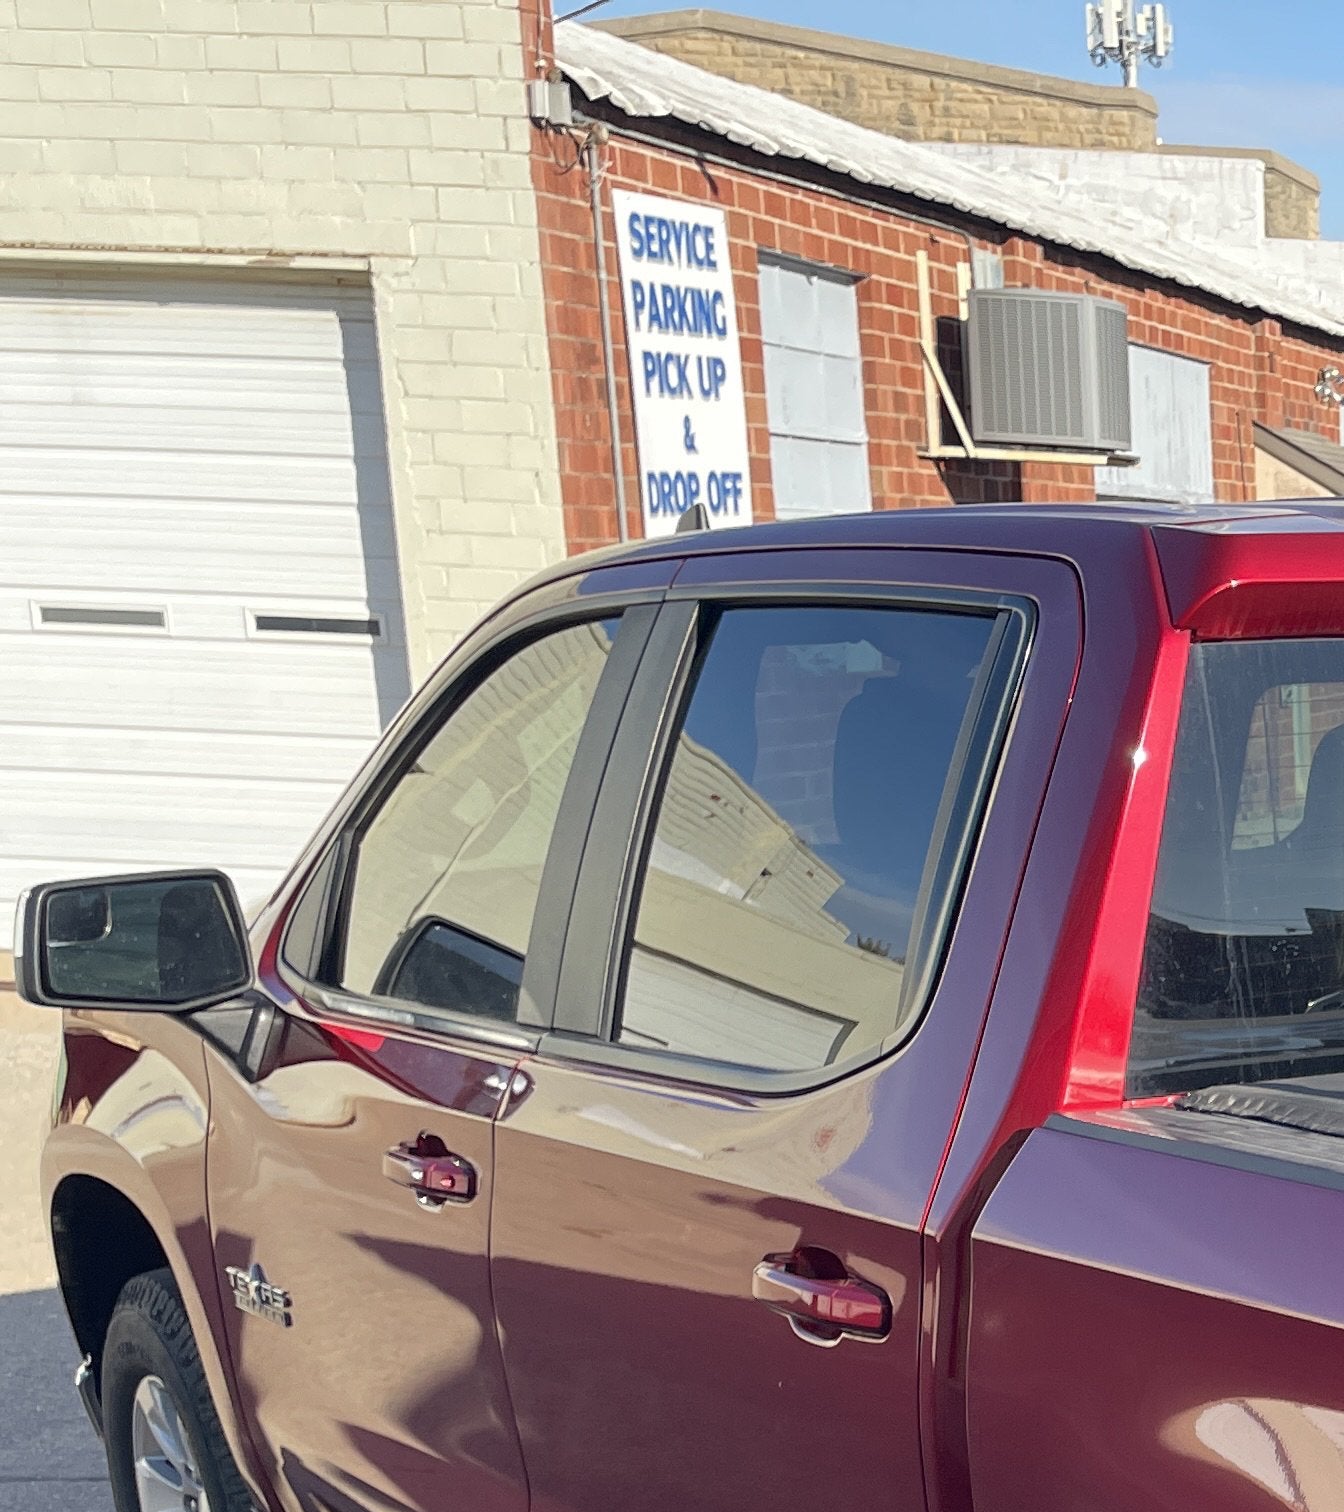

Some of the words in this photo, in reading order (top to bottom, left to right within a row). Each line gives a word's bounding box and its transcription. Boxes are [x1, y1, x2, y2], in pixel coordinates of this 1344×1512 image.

[628, 211, 717, 268] SERVICE
[631, 280, 726, 336] PARKING
[642, 351, 691, 397] PICK
[697, 356, 726, 399] UP
[684, 415, 698, 453] &
[647, 471, 700, 515] DROP
[707, 470, 742, 514] OFF
